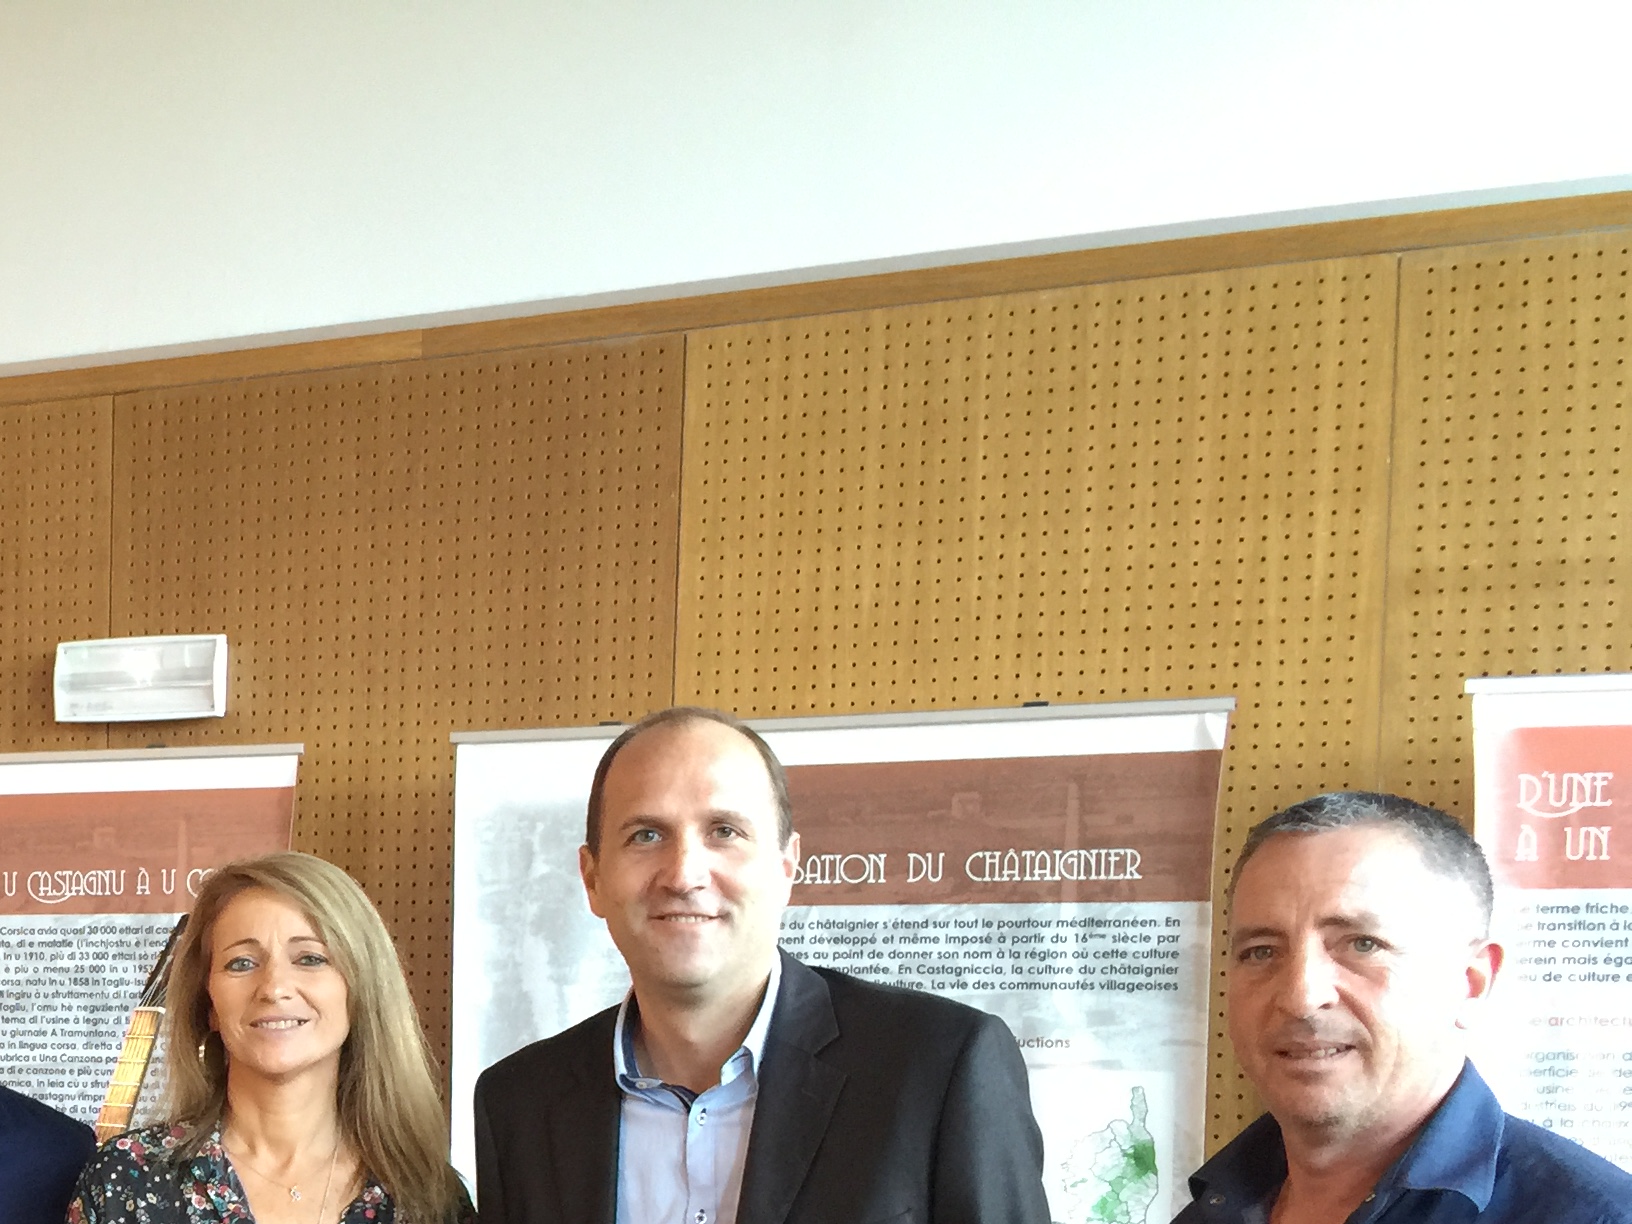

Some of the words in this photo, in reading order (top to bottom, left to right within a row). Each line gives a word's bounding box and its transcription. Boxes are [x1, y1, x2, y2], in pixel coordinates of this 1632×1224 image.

[1516, 771, 1613, 818] D'UNE
[1514, 824, 1539, 861] À
[1563, 826, 1613, 861] UN
[792, 854, 887, 884] SATION
[907, 853, 945, 882] DU
[965, 848, 1143, 881] CHÂTAIGNIER
[2, 871, 18, 897] U
[27, 869, 126, 904] CASTAGNU
[136, 867, 151, 895] À
[161, 869, 177, 895] U
[0, 926, 36, 935] Corsica
[99, 926, 117, 934] 000
[118, 926, 144, 936] ettari
[144, 926, 154, 934] di
[788, 920, 805, 929] du
[807, 918, 880, 932] châtaignier
[882, 918, 929, 929] s'étend
[932, 920, 951, 928] sur
[953, 918, 979, 928] tout
[981, 918, 994, 928] le
[997, 918, 1052, 932] pourtour
[1165, 918, 1181, 927] En
[16, 940, 26, 948] di
[808, 932, 877, 947] développé
[881, 934, 894, 944] et
[898, 932, 940, 944] même
[944, 932, 993, 946] imposé
[997, 932, 1006, 943] à
[1011, 932, 1046, 946] partir
[1050, 932, 1068, 943] du
[1111, 932, 1152, 943] siècle
[1156, 934, 1181, 946] par
[1561, 936, 1629, 949] convient
[3, 952, 12, 960] In
[23, 952, 48, 960] 1910,
[49, 952, 65, 962] più
[66, 952, 76, 960] di
[78, 952, 90, 961] 33
[92, 952, 109, 960] 000
[111, 952, 137, 960] ettari
[832, 948, 864, 961] point
[867, 948, 884, 959] de
[887, 948, 933, 960] donner
[936, 950, 959, 959] son
[963, 950, 992, 959] nom
[996, 948, 1005, 959] à
[1008, 948, 1021, 959] la
[1024, 948, 1068, 962] région
[1071, 948, 1089, 959] où
[1092, 948, 1128, 959] cette
[1132, 948, 1180, 959] culture
[1562, 953, 1599, 966] mais
[42, 966, 70, 974] menu
[74, 964, 85, 973] 25
[88, 964, 106, 973] 000
[109, 964, 118, 973] in
[898, 964, 912, 974] En
[1011, 964, 1023, 974] la
[1027, 964, 1074, 975] culture
[1078, 964, 1096, 975] du
[1100, 964, 1179, 977] châtaignier
[25, 978, 47, 986] natu
[48, 976, 57, 986] in
[68, 976, 90, 986] 1858
[91, 976, 100, 986] in
[1567, 971, 1621, 983] culture
[931, 978, 945, 990] La
[949, 978, 969, 990] vie
[972, 980, 996, 990] des
[999, 978, 1096, 990] communautés
[1098, 980, 1179, 993] villageoises
[112, 990, 122, 999] di
[76, 1002, 130, 1013] neguziente
[1, 1014, 26, 1024] tema
[28, 1014, 38, 1024] di
[82, 1016, 110, 1026] legnu
[112, 1016, 122, 1025] di
[9, 1028, 47, 1038] giurnale
[7, 1040, 17, 1049] in
[18, 1040, 47, 1051] lingua
[82, 1040, 113, 1050] diretta
[39, 1054, 57, 1063] Una
[59, 1052, 103, 1063] Canzona
[6, 1066, 16, 1075] di
[77, 1066, 92, 1077] più
[36, 1078, 46, 1087] in
[47, 1078, 65, 1088] leia
